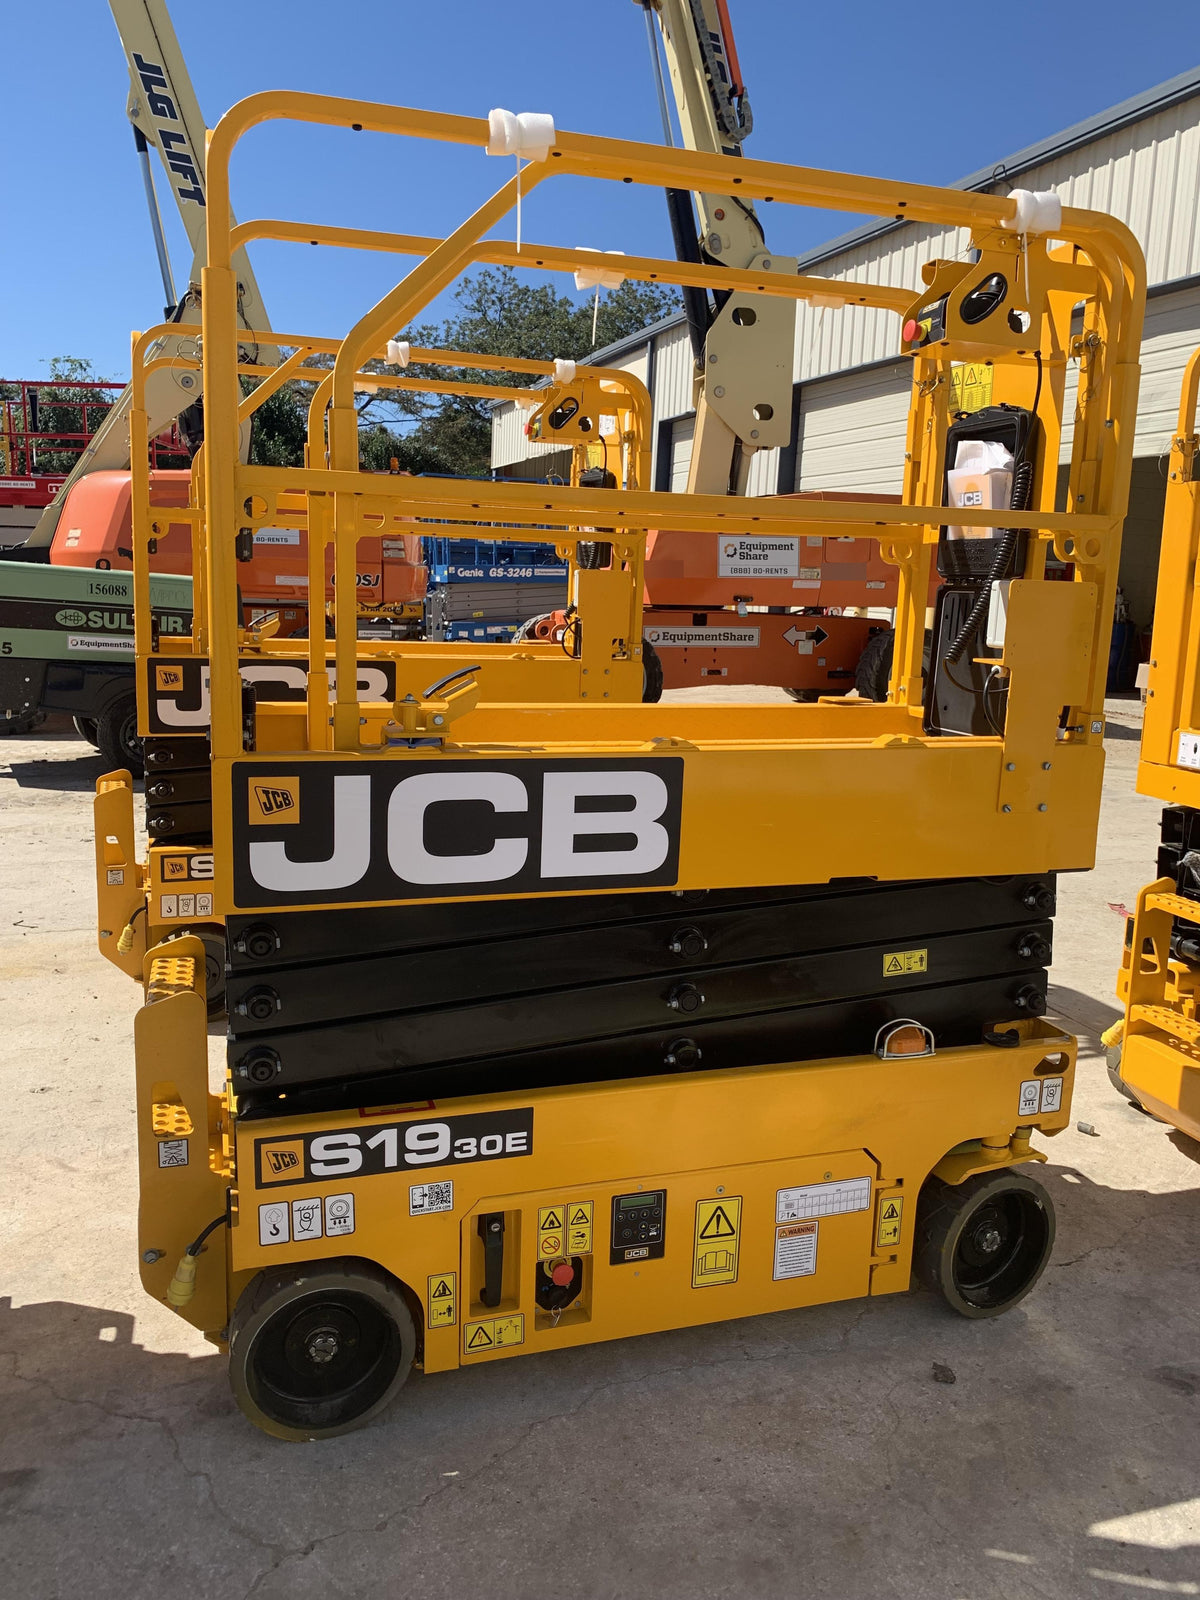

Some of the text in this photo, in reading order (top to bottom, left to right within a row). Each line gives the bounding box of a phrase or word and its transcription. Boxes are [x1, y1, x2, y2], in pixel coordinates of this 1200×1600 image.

[131, 52, 206, 208] JLG LIFT
[957, 491, 983, 507] JCB
[739, 541, 794, 552] Equipment
[739, 551, 769, 561] Share
[457, 567, 484, 578] Genie
[489, 567, 533, 578] GS-3246
[89, 583, 128, 597] 156088
[87, 610, 183, 633] SULIR
[662, 631, 755, 643] EquipmentShare
[162, 670, 180, 685] JCB
[260, 788, 293, 814] JCB
[249, 770, 669, 892] JCB
[271, 1151, 298, 1172] JCB
[788, 1225, 815, 1236] WARNING
[626, 1248, 648, 1258] JCB
